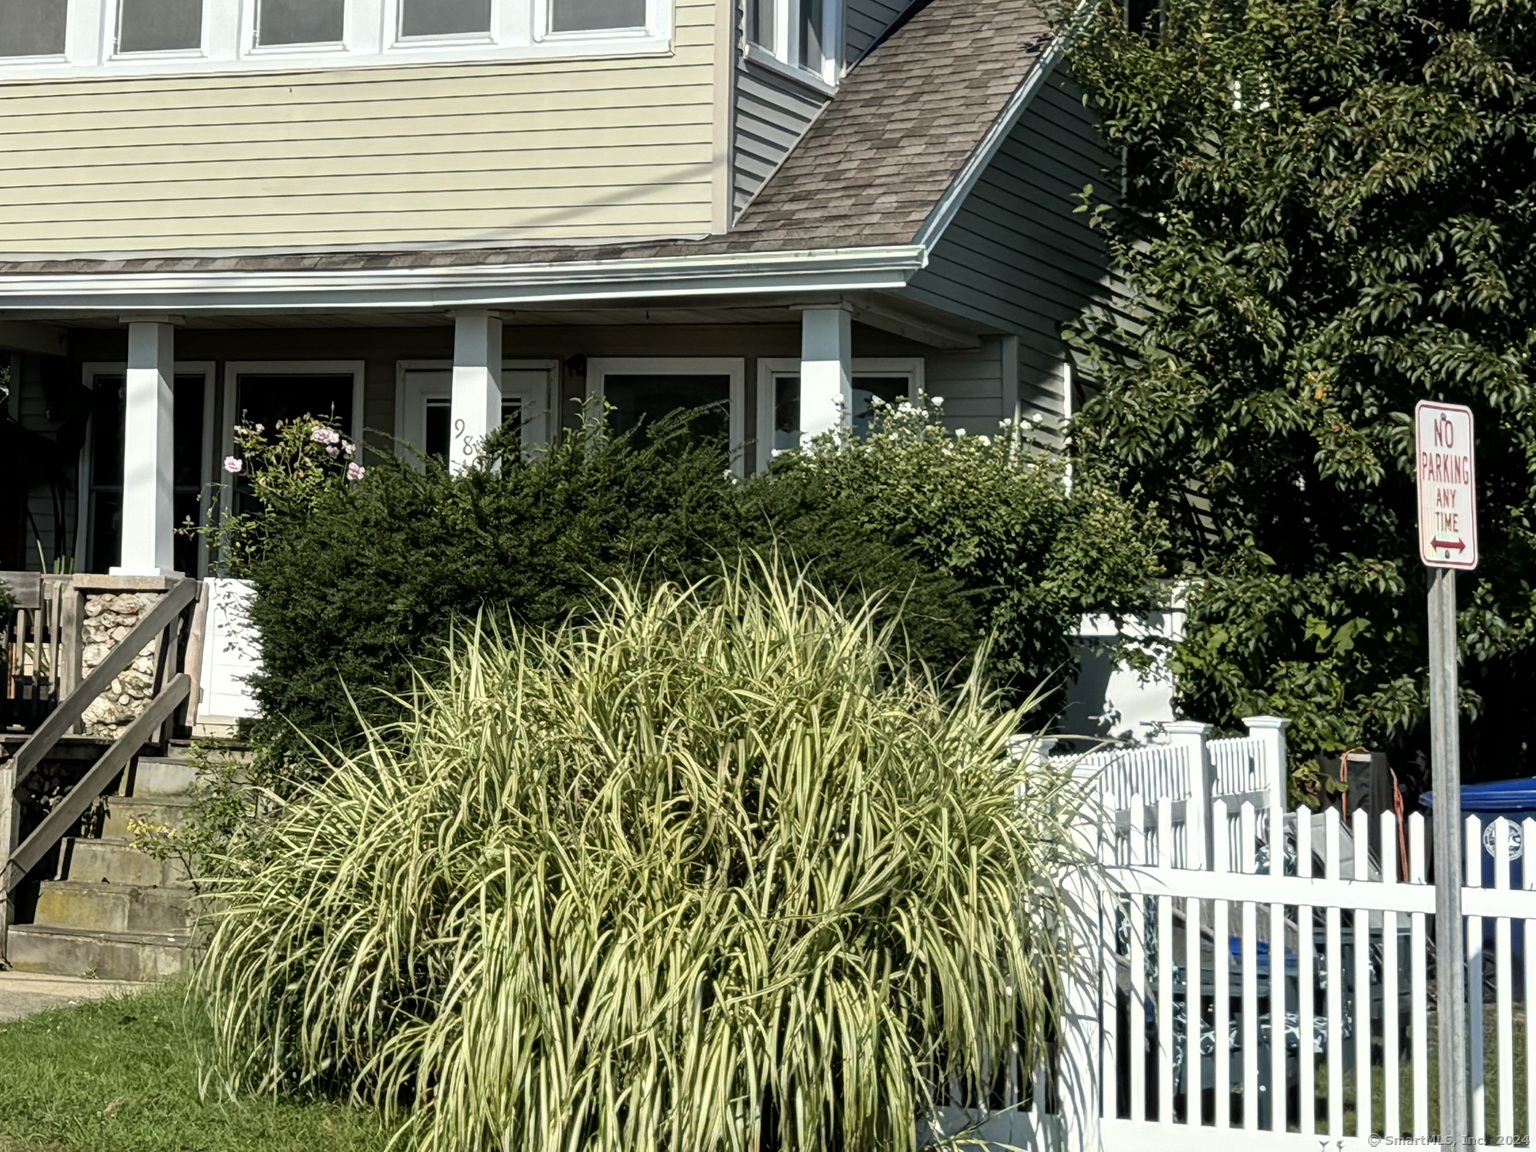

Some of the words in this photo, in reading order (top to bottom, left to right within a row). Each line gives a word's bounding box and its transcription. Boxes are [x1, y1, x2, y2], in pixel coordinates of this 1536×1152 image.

[1434, 418, 1454, 448] NO
[1422, 452, 1469, 485] PARKING
[1436, 488, 1456, 508] ANY
[1435, 511, 1459, 532] TIME
